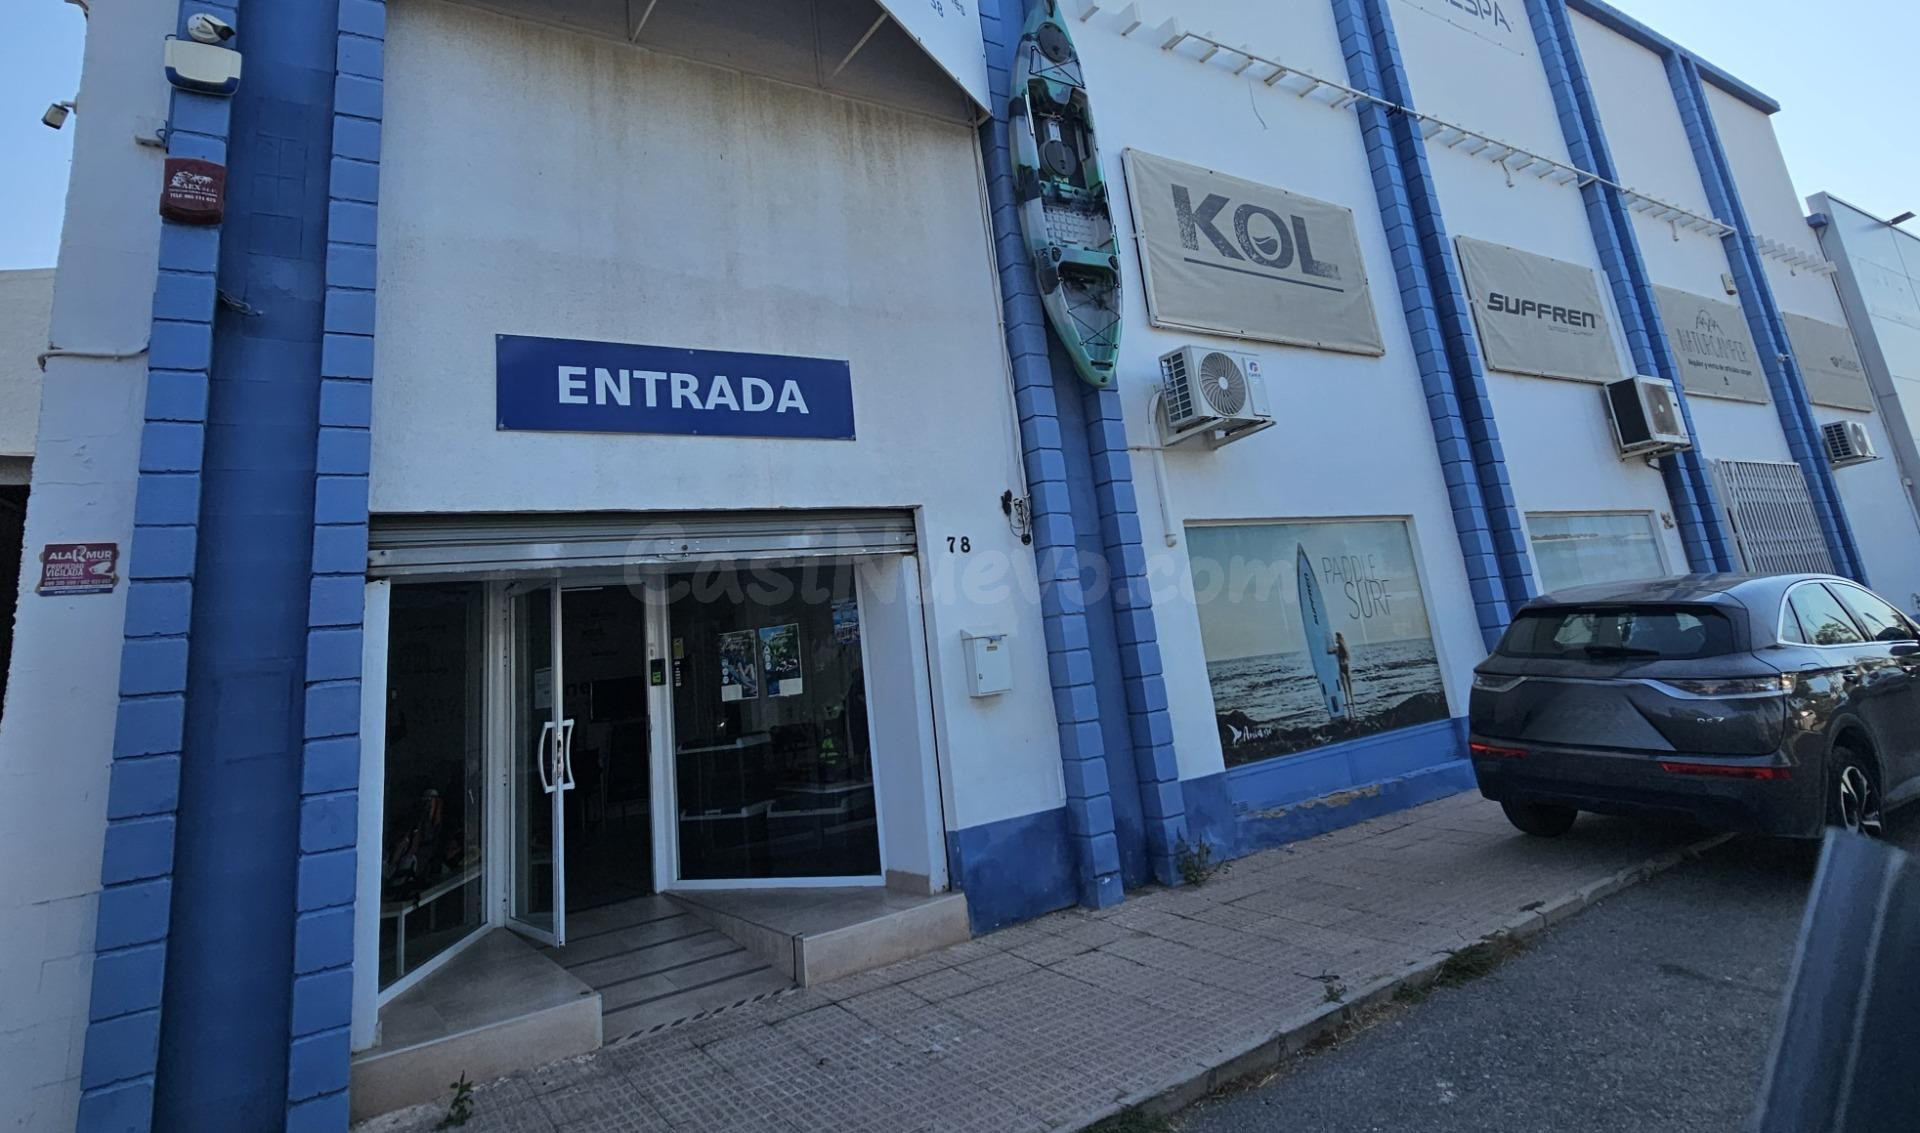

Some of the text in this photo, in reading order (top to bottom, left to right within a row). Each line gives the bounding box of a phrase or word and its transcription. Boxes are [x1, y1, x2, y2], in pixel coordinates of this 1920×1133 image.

[1171, 184, 1341, 281] KOL
[558, 365, 809, 414] ENTRADA
[48, 545, 112, 562] ALARMUR
[946, 536, 971, 554] 78
[46, 568, 84, 577] VIGILADA
[1321, 553, 1378, 585] PADDLE
[1344, 579, 1392, 620] SURF
